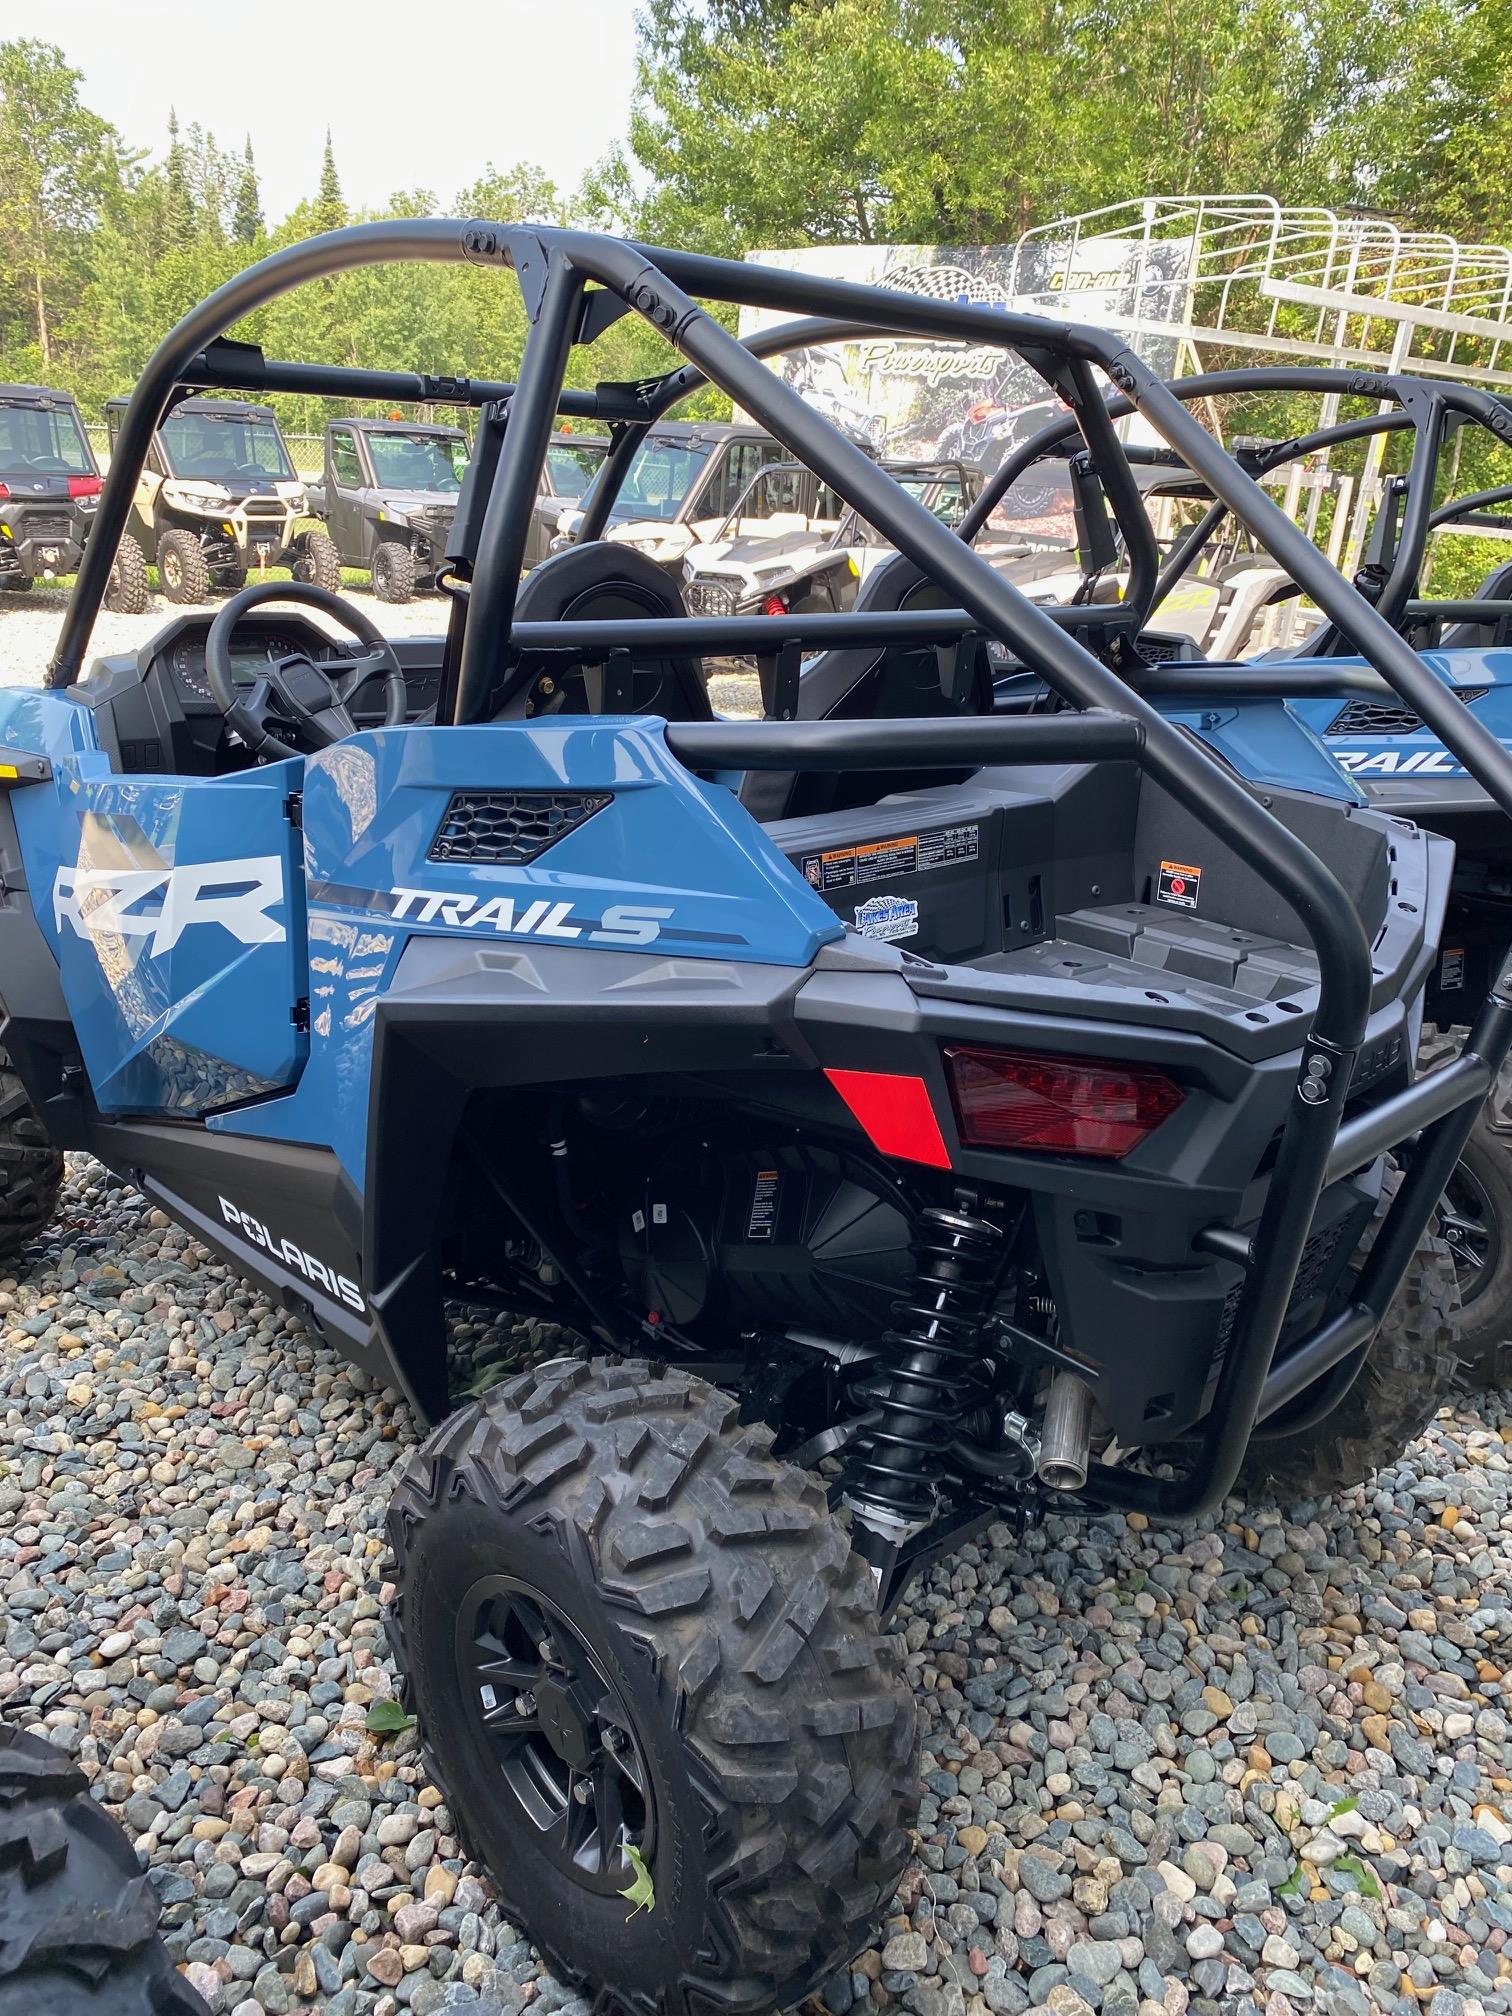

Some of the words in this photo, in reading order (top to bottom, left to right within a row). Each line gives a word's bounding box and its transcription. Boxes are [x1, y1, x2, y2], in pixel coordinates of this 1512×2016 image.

[861, 343, 1004, 385] Powersports
[1333, 752, 1454, 772] RAIL
[53, 855, 287, 959] RZR
[389, 886, 583, 938] TRAIL
[588, 904, 675, 946] S
[857, 908, 889, 929] LAKES
[890, 902, 916, 921] AREA
[218, 1194, 366, 1313] POLARIS
